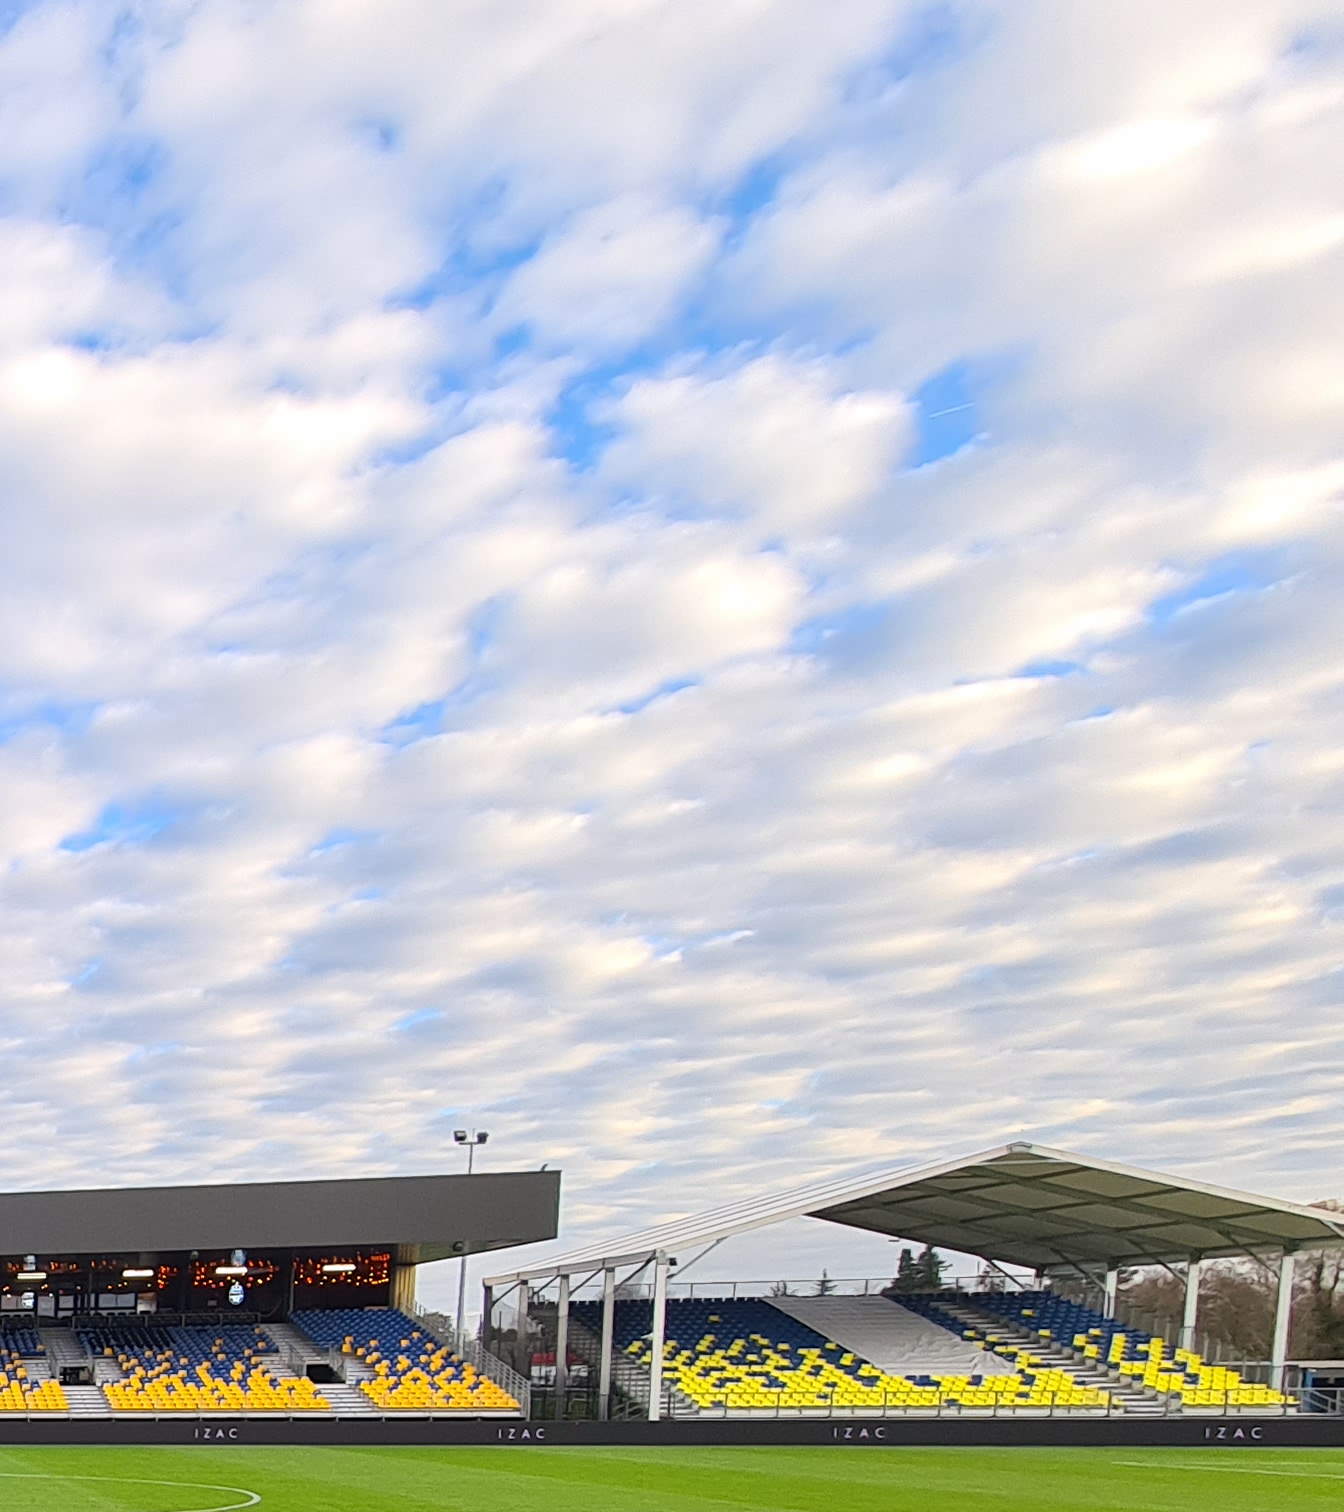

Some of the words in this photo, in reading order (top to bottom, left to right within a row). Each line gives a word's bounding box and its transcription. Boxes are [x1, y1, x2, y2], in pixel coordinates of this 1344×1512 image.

[194, 1428, 237, 1439] IZAC
[497, 1428, 545, 1439] IZAC
[833, 1427, 886, 1439] IZAC
[1204, 1427, 1263, 1439] IZAC
